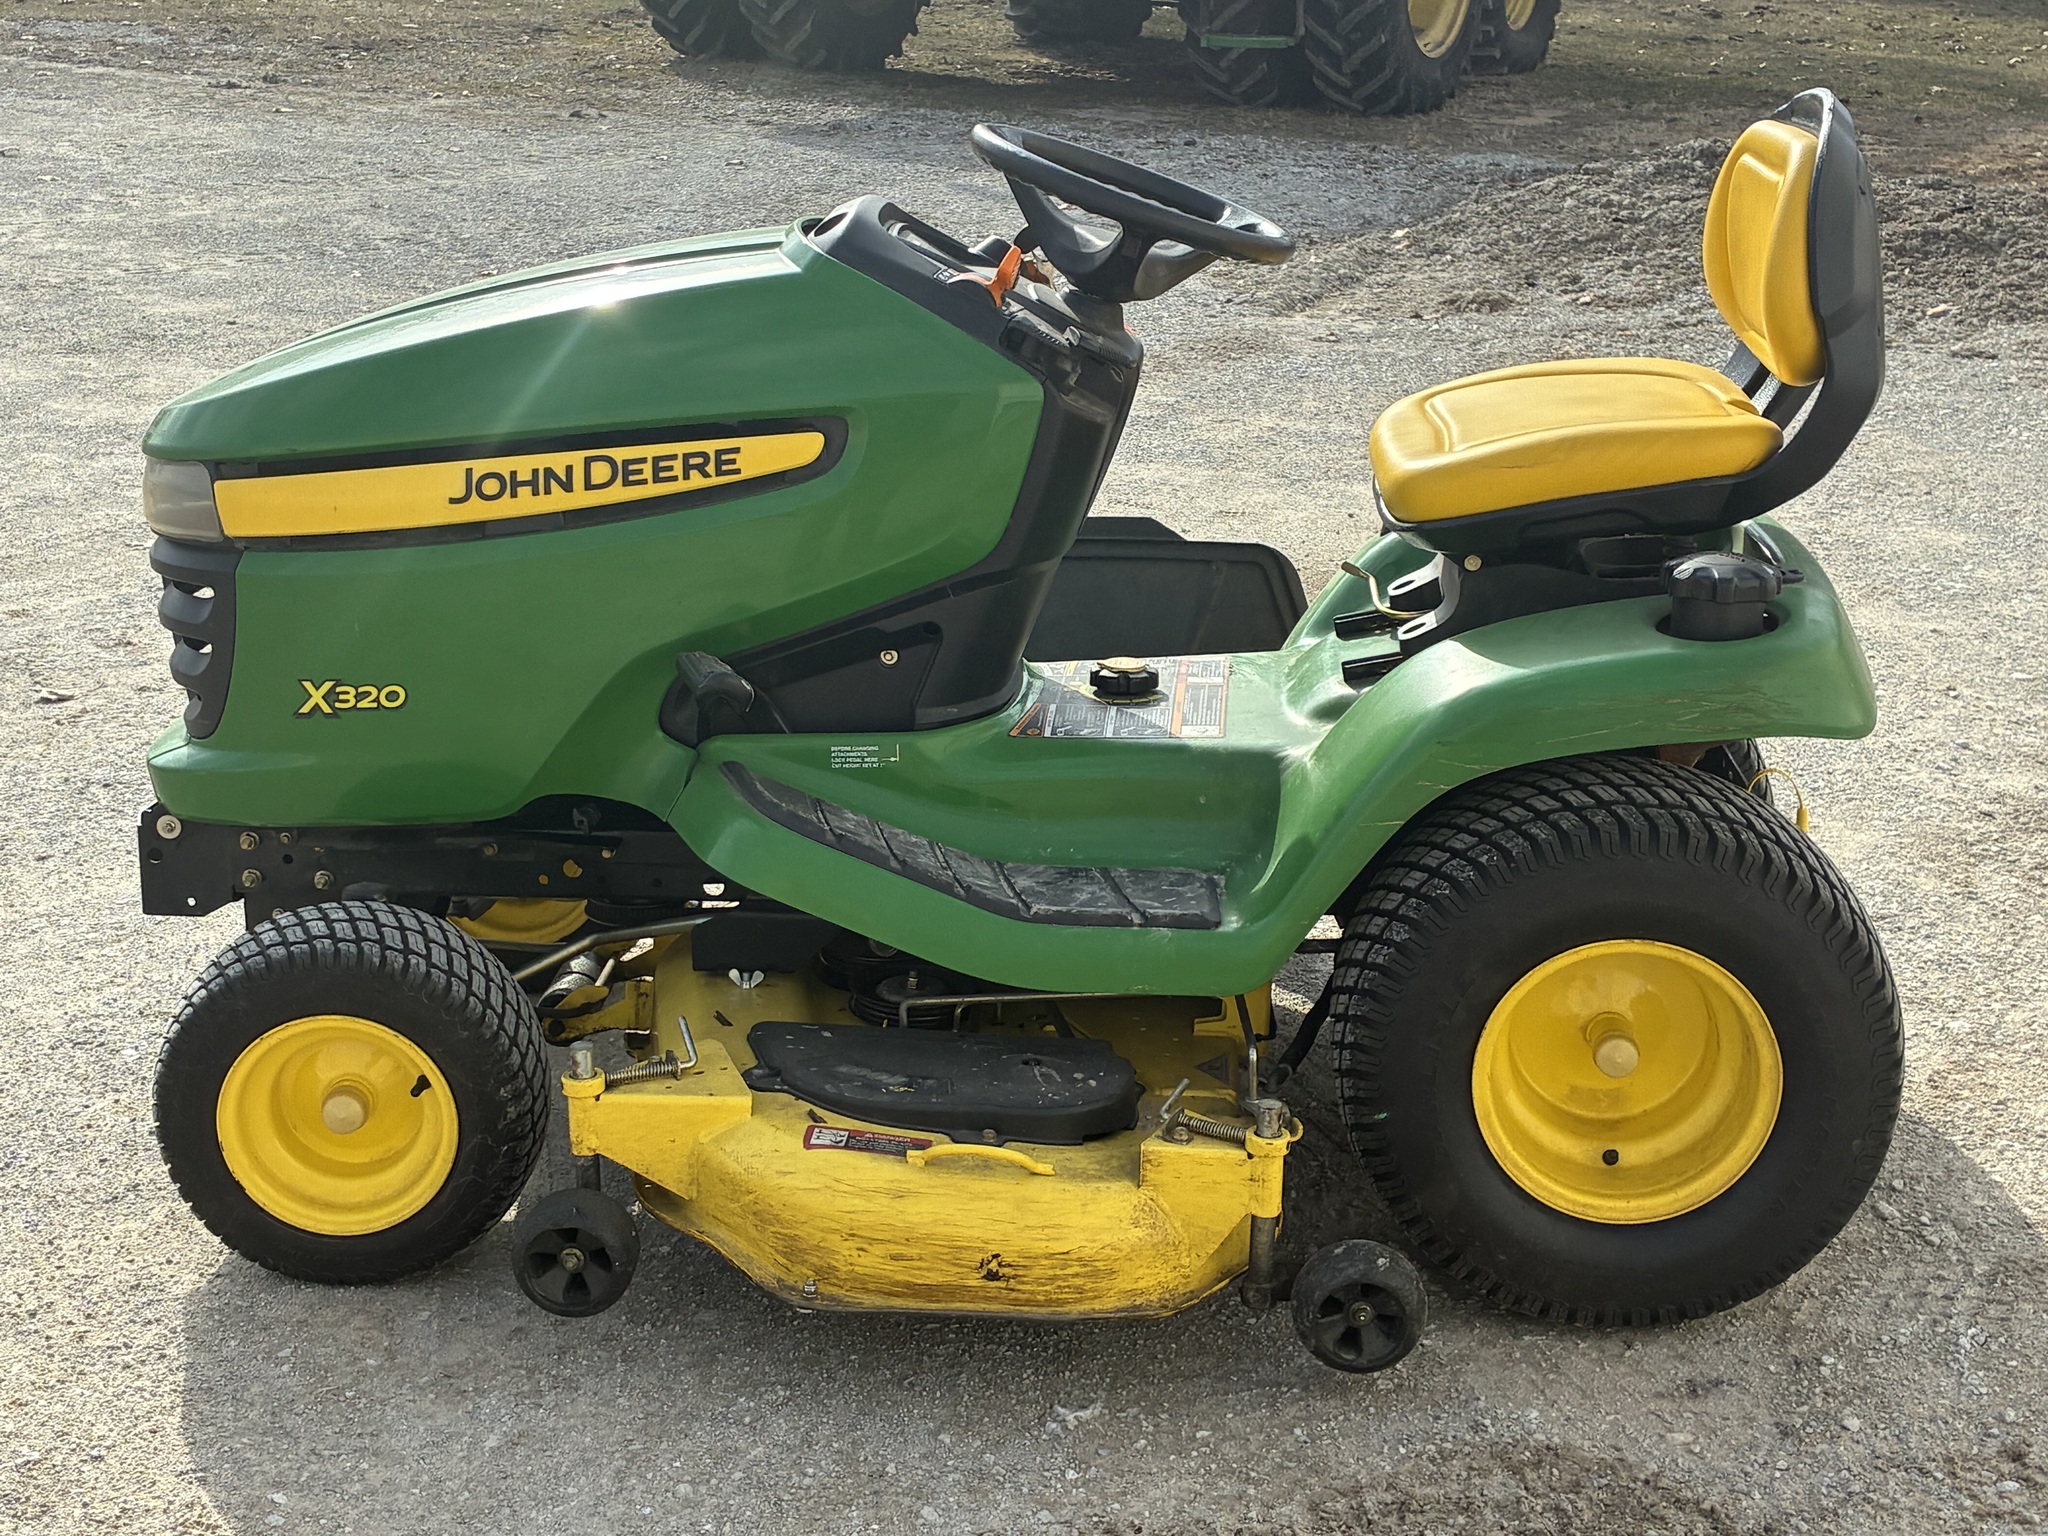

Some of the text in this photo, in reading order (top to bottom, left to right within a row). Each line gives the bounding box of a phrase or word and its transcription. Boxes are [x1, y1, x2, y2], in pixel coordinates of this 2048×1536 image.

[448, 446, 742, 505] JOHN DEERE
[294, 679, 408, 718] X320
